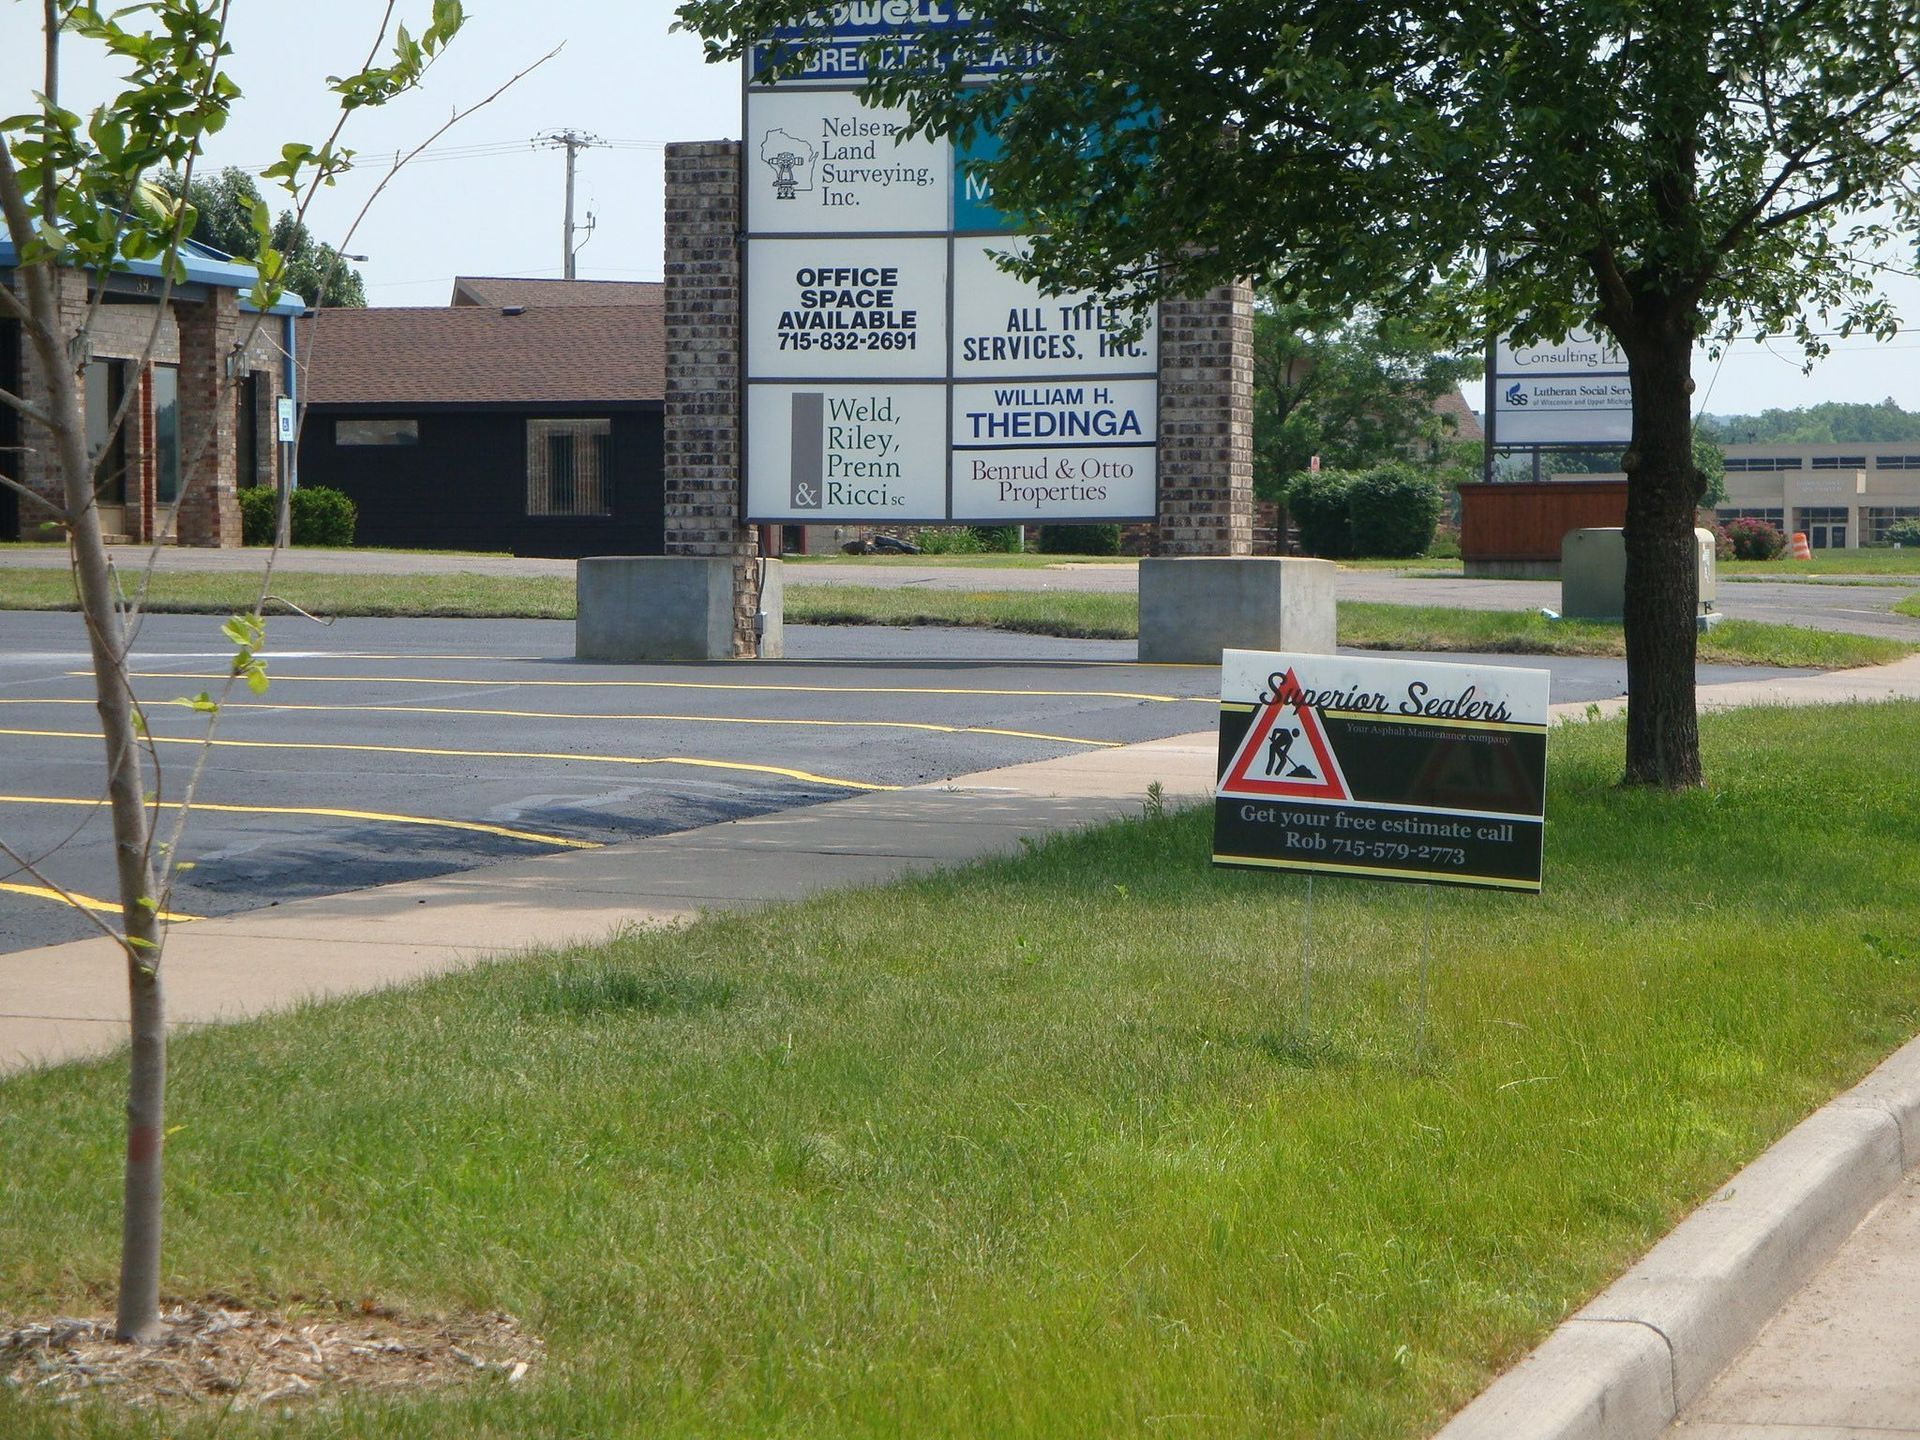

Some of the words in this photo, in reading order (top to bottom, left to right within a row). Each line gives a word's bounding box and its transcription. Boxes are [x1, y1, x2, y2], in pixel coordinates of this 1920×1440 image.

[822, 117, 897, 137] Nelsen
[822, 140, 877, 160] Land
[822, 162, 935, 187] Surveying,
[822, 186, 860, 206] Inc.
[795, 267, 899, 287] OFFICE
[800, 289, 894, 308] SPACE
[777, 310, 917, 330] AVAILABLE
[1007, 307, 1047, 333] ALL
[778, 331, 917, 351] 715-832-2691
[963, 334, 1083, 361] SERVICES,
[1099, 333, 1148, 358] INC.
[1514, 347, 1598, 367] Consulting
[994, 388, 1083, 406] WILLIAM
[1094, 388, 1114, 405] H.
[1505, 390, 1528, 406] LSS
[1533, 386, 1577, 397] Lutheran
[1580, 385, 1608, 396] Social
[828, 397, 901, 424] Weld,
[966, 409, 1142, 438] THEDINGA
[828, 426, 901, 456] Riley,
[827, 455, 901, 477] Prenn
[972, 457, 1048, 481] Benrud
[1055, 458, 1076, 480] &
[1081, 457, 1134, 479] Otto
[795, 482, 818, 506] &
[827, 482, 888, 505] Ricci
[999, 479, 1107, 508] Properties
[1259, 671, 1390, 715] Superior
[1399, 681, 1512, 723] Sealers
[1346, 723, 1368, 734] Your
[1371, 725, 1406, 737] Asphalt
[1408, 727, 1467, 742] Maintenance
[1468, 735, 1511, 746] company
[1240, 804, 1277, 823] Get
[1280, 809, 1330, 831] your
[1335, 811, 1376, 831] free
[1381, 815, 1473, 840] estimate
[1477, 825, 1514, 843] call
[1286, 831, 1327, 851] Rob
[1332, 838, 1466, 866] 715-579-2773
